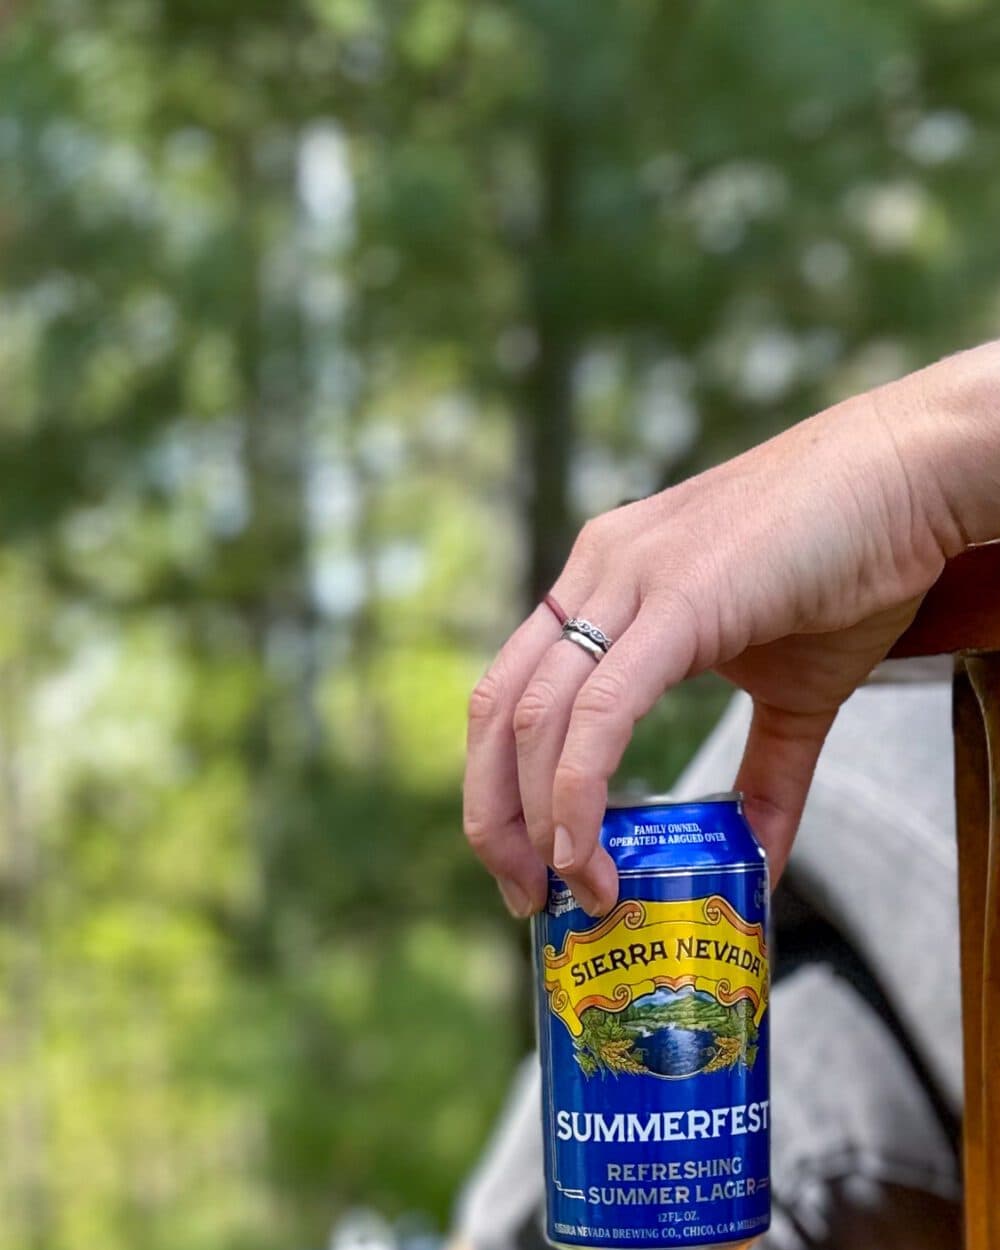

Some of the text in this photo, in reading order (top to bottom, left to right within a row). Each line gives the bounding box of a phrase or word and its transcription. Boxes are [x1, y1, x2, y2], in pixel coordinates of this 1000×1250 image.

[609, 832, 727, 847] OPERATED & ARGUED OVER
[634, 824, 667, 835] FAMILY
[570, 940, 668, 987] SIERRA
[557, 1101, 769, 1142] SUMMERFEST
[607, 1157, 743, 1182] REFRESHING
[588, 1178, 756, 1205] SUMMER LAGER
[577, 1225, 611, 1238] NEVADA
[612, 1228, 659, 1239] BREWING
[683, 1225, 716, 1237] CHICO,
[716, 1223, 729, 1234] CA
